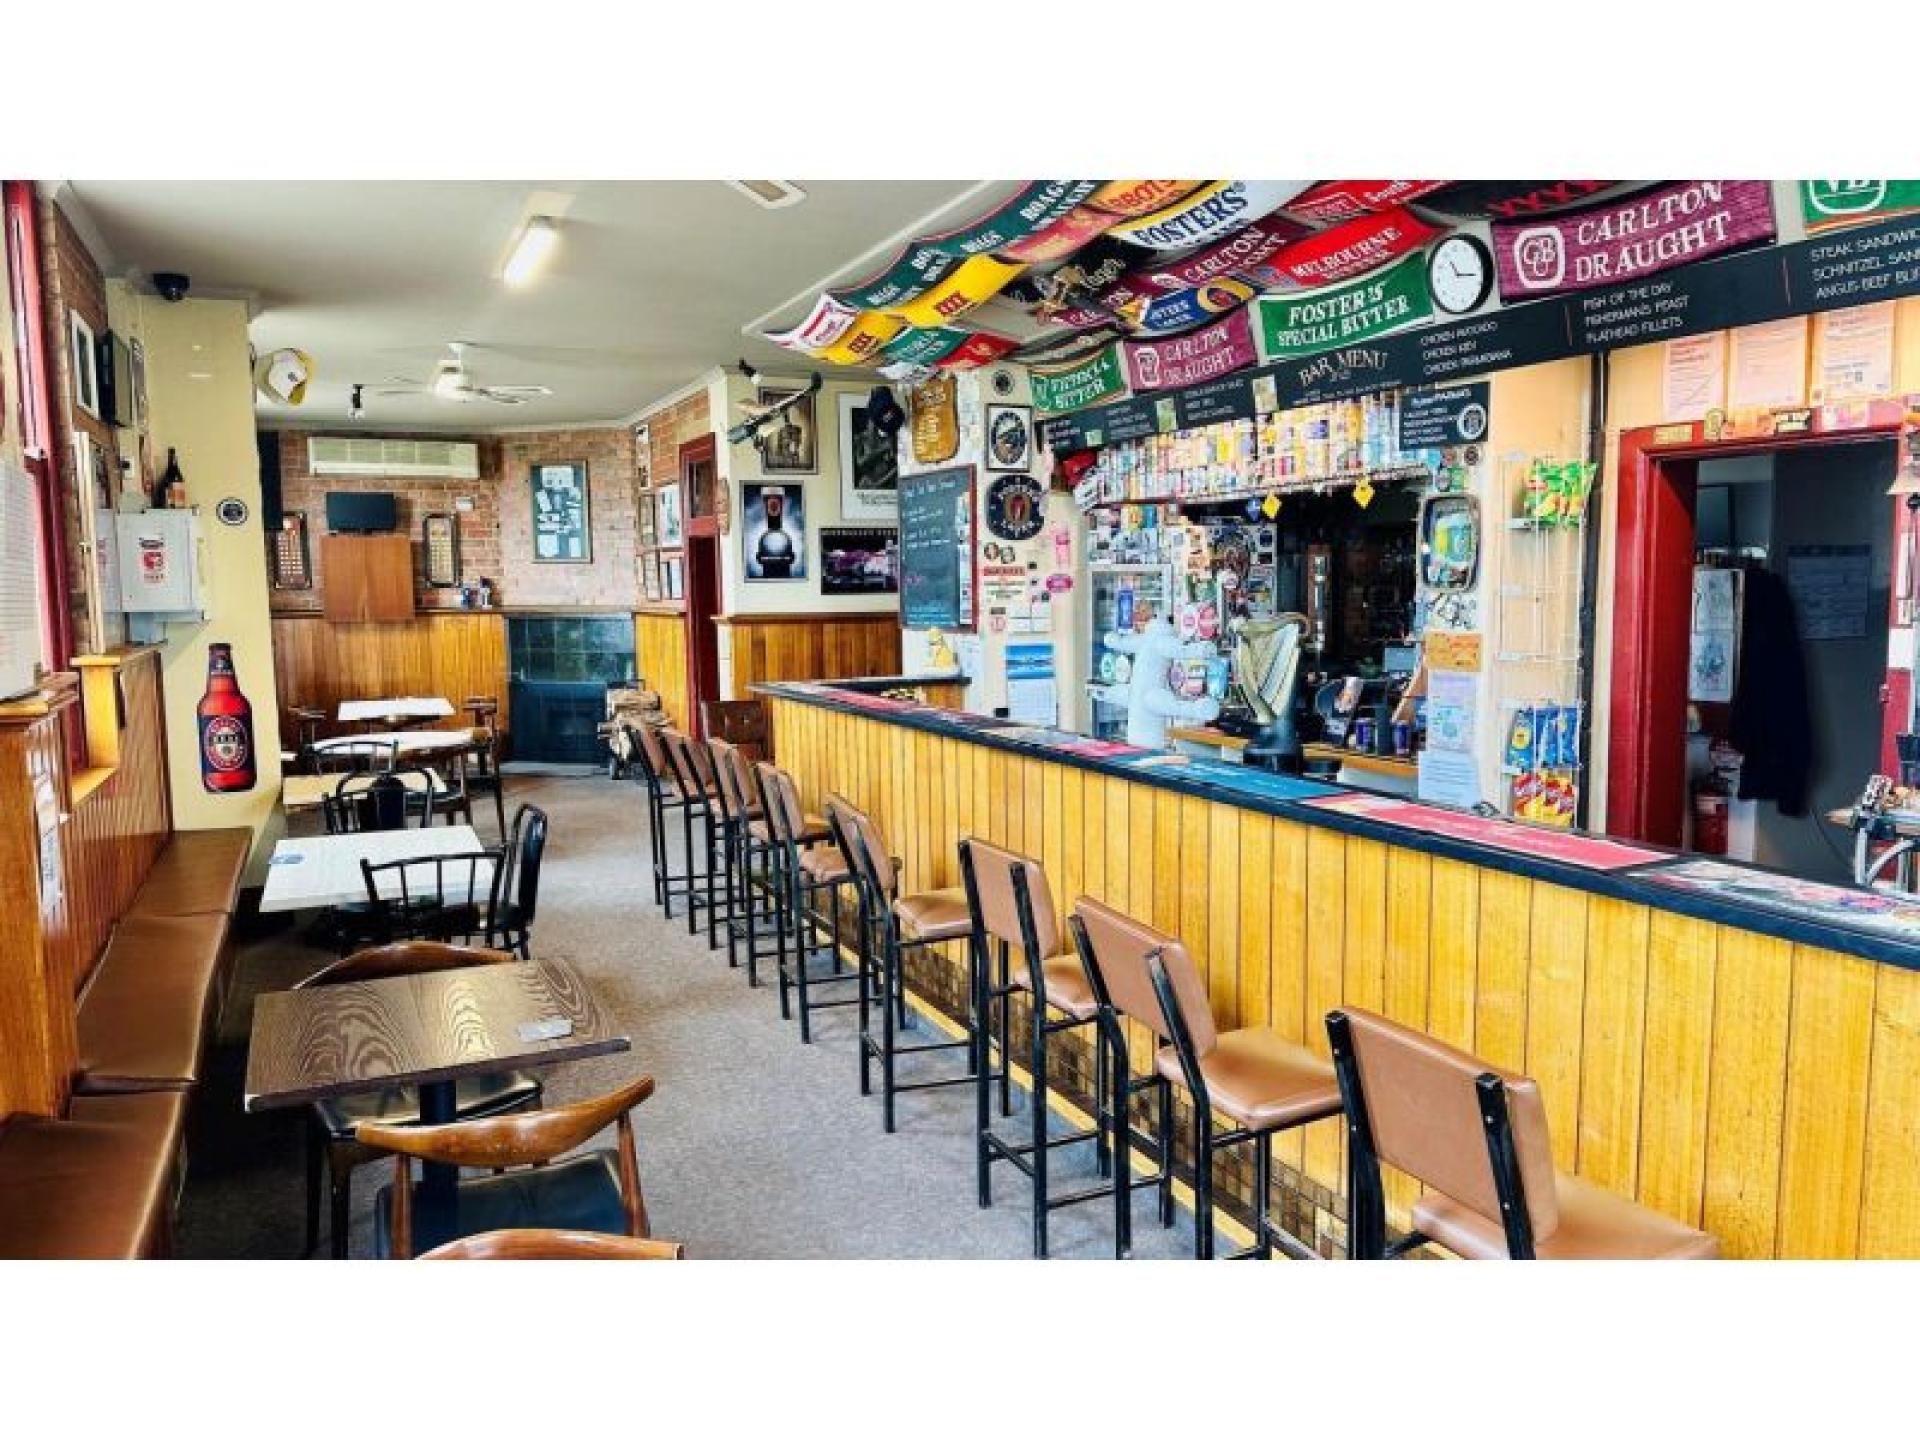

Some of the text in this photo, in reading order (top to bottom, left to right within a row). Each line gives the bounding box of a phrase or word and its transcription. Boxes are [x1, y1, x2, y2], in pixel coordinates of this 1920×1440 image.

[1577, 180, 1724, 246] CARLTON
[1184, 225, 1267, 282] CARLTON
[1290, 227, 1403, 278] MELBOURNE
[1575, 210, 1732, 282] DRAUGHT
[1810, 241, 1854, 262] STEAK
[1277, 294, 1411, 347] SPECIAL BITTER
[1288, 281, 1388, 327] FOSTER'S
[1163, 345, 1235, 386] DRAUGHT
[1165, 325, 1229, 361] CARLTON
[1298, 356, 1333, 387] BAR
[1336, 349, 1388, 370] MENU
[1055, 378, 1107, 410] BITTER
